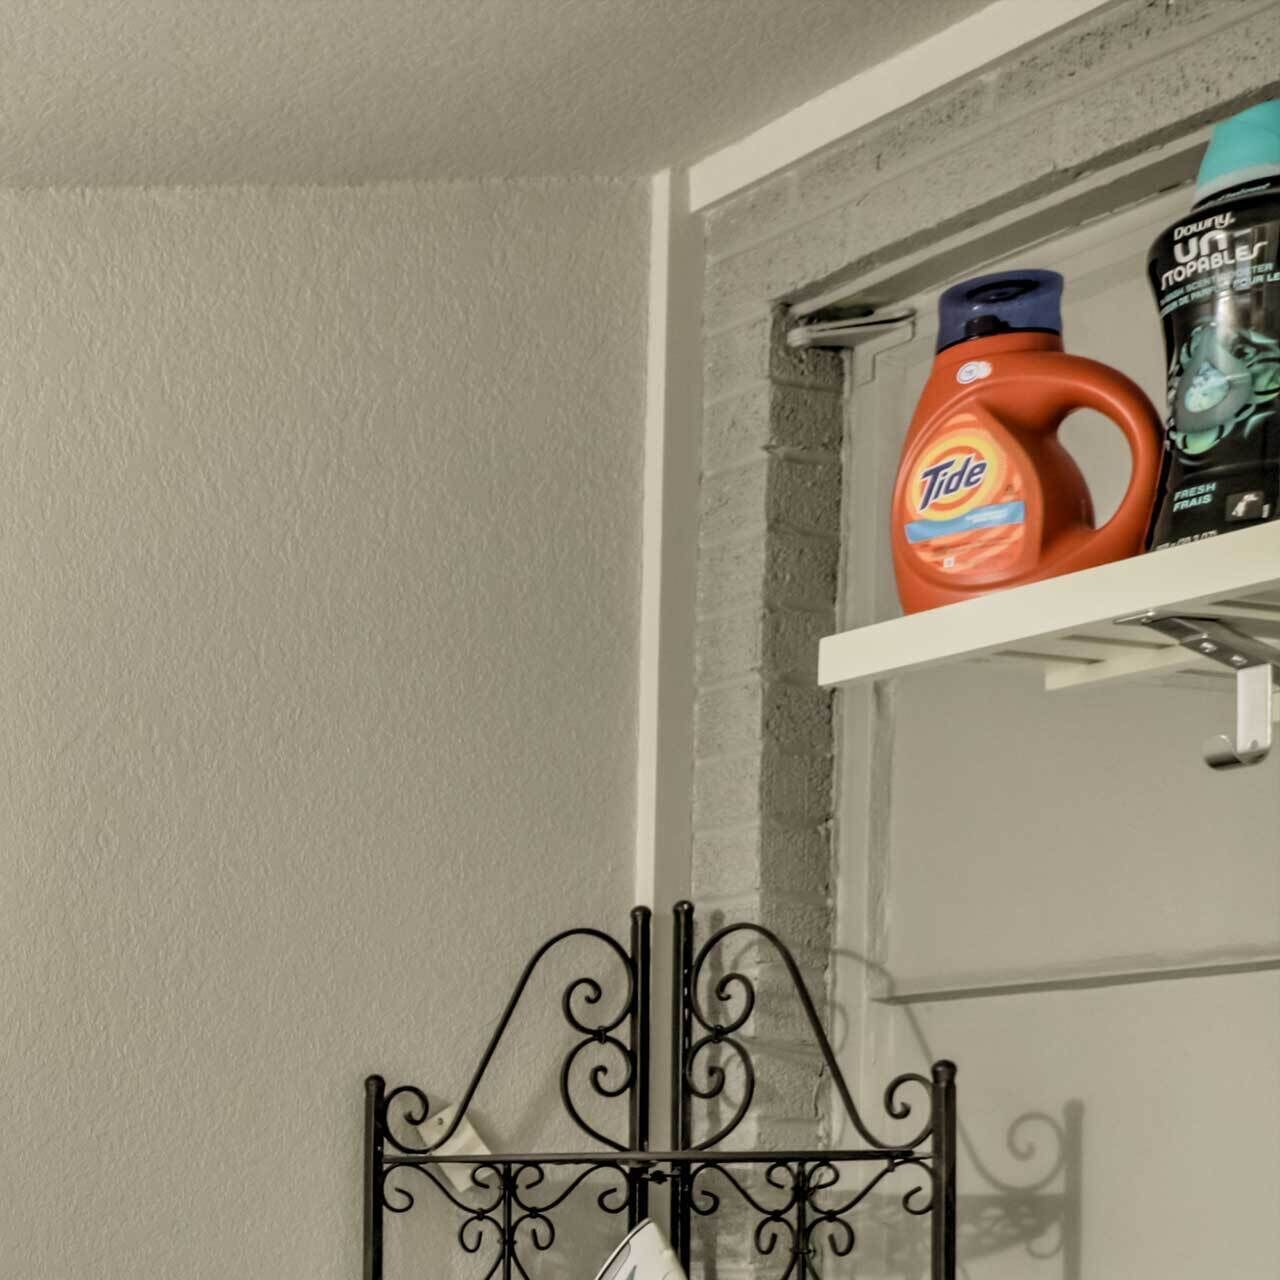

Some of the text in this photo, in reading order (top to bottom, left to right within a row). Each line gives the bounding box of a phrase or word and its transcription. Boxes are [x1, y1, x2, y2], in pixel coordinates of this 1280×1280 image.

[1174, 211, 1233, 241] Downy
[1161, 240, 1269, 291] STOPABLES
[920, 456, 988, 511] Tide
[1173, 482, 1217, 501] FRESH
[1173, 494, 1213, 512] FRAIS
